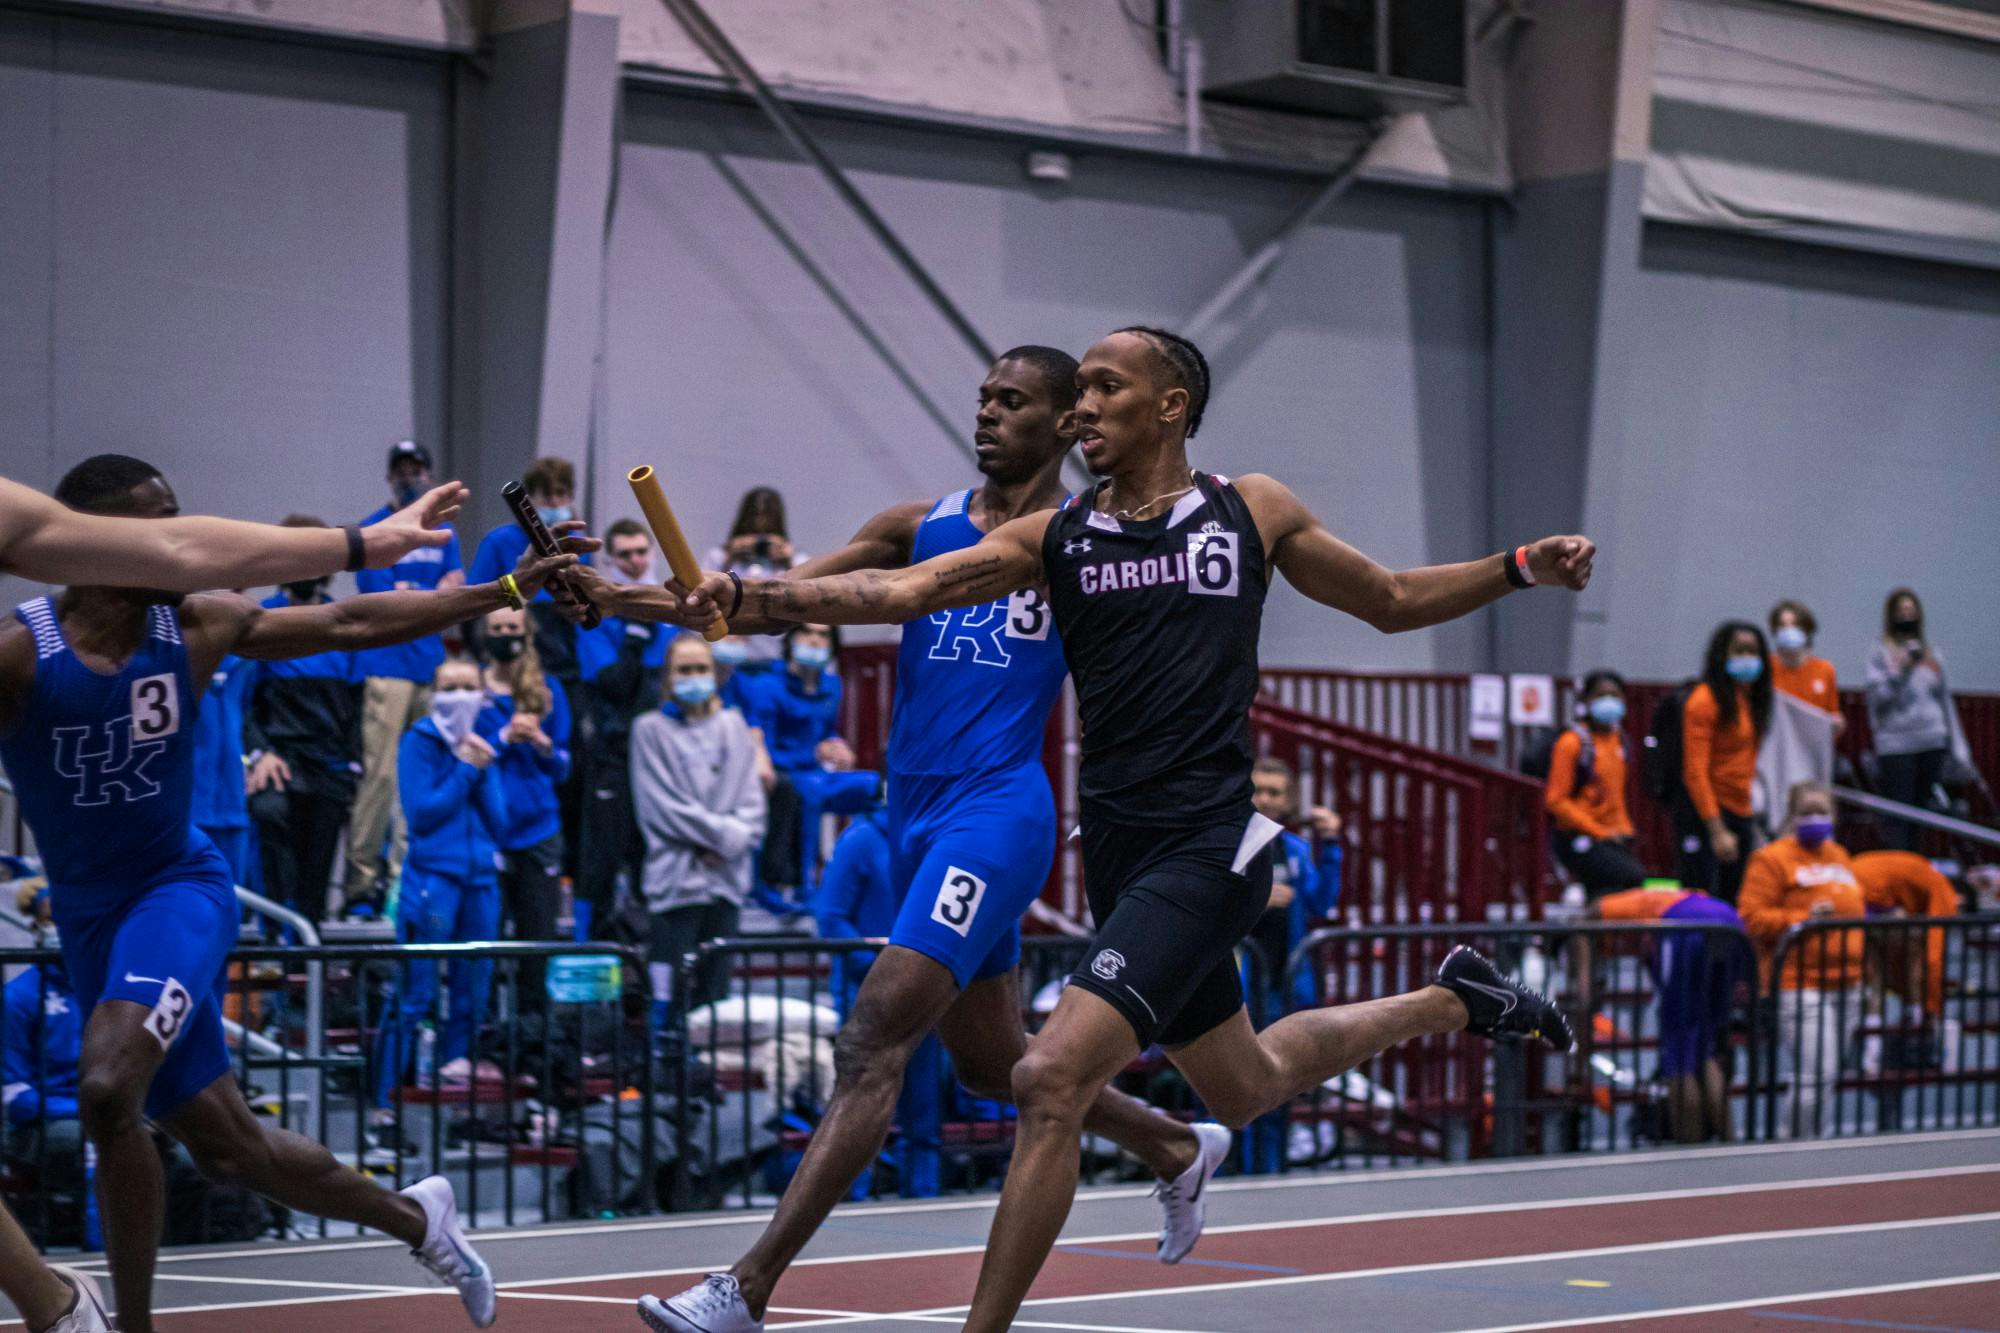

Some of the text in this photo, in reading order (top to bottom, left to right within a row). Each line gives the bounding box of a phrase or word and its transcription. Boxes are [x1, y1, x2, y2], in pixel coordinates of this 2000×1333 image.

[1080, 552, 1190, 595] CAROLI
[1195, 535, 1233, 591] 6
[1012, 587, 1045, 636] 3
[137, 679, 172, 735] 3
[940, 874, 978, 927] 3
[155, 988, 188, 1041] 3
